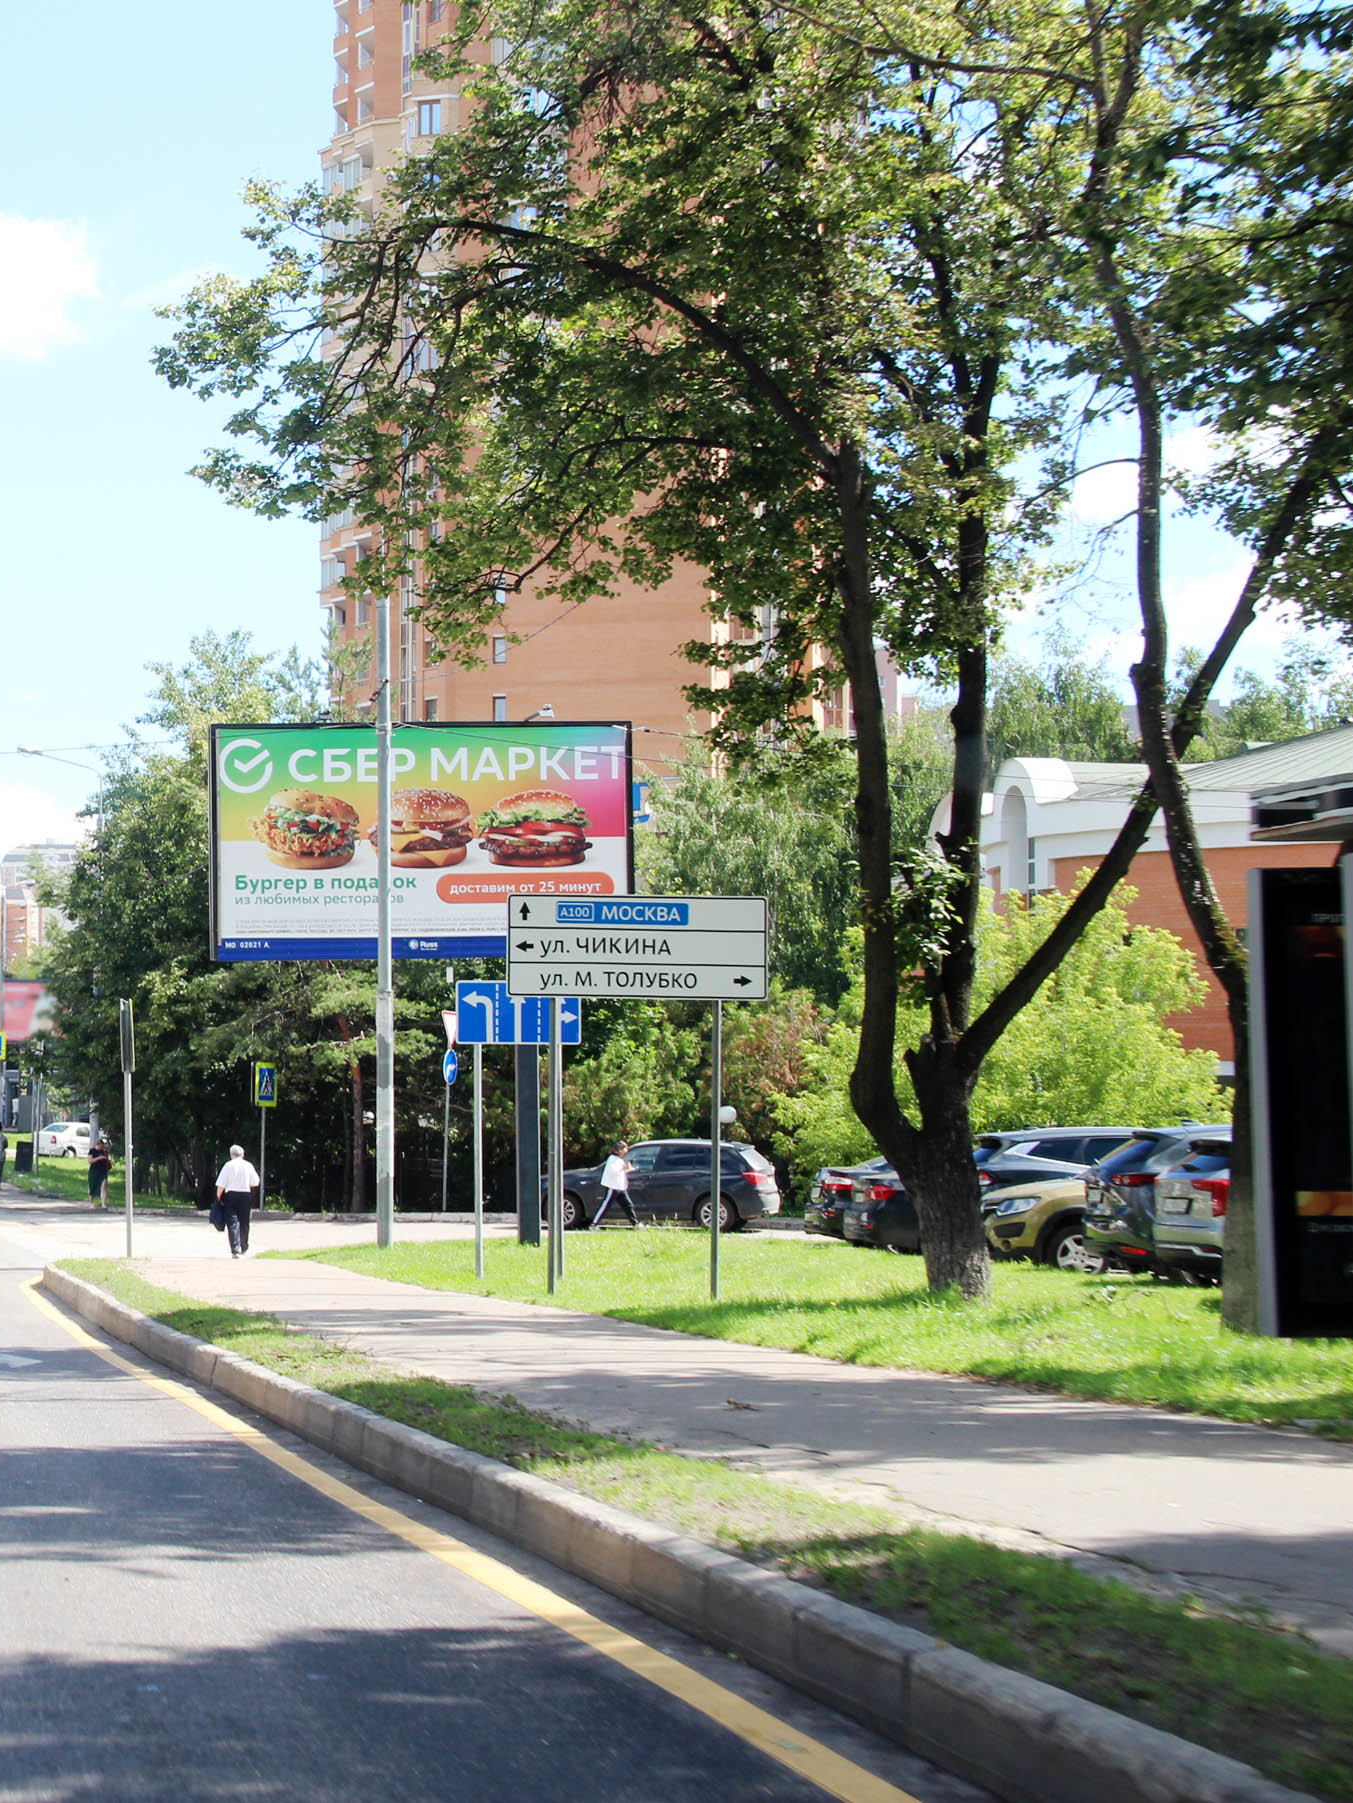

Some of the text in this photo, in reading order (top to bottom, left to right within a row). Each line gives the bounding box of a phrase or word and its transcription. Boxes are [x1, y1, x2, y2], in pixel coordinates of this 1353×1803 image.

[288, 746, 625, 783] СБЕР МАРКЕТ
[235, 875, 417, 895] Бургер в подаок
[450, 881, 601, 895] доставим от 25 минут
[235, 897, 250, 905] из
[254, 893, 319, 905] любимых
[560, 907, 590, 918] А100
[601, 905, 681, 922] МОСКВА
[540, 937, 671, 958] ул. ЧИКИНА
[540, 971, 697, 990] ул. М. ТОЛУБКО
